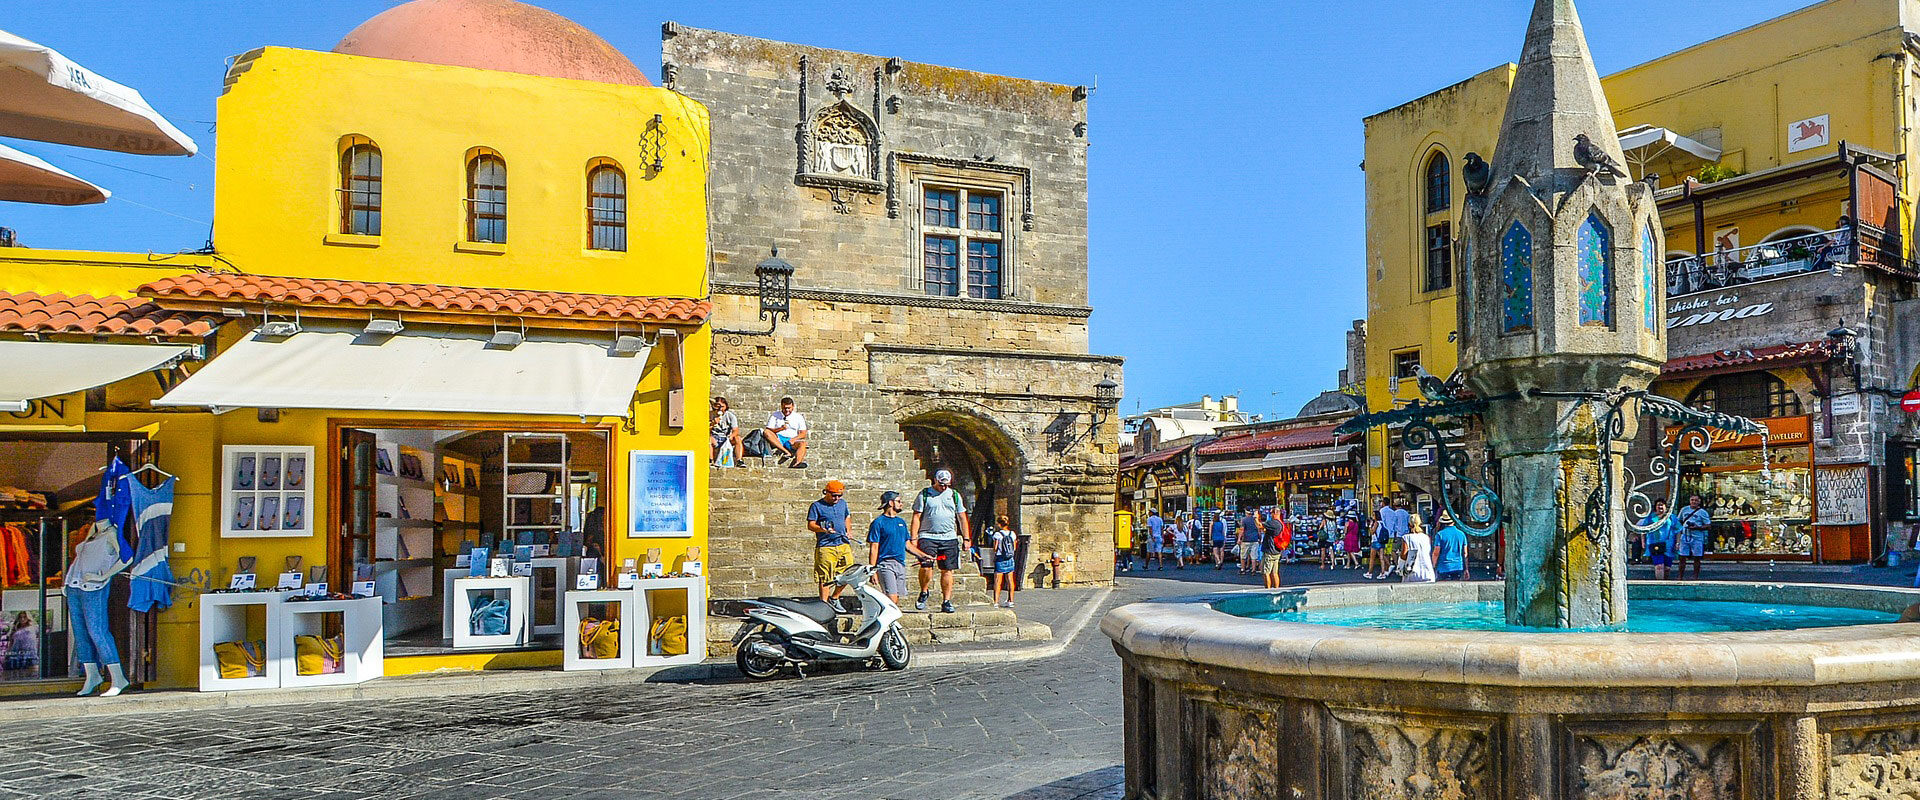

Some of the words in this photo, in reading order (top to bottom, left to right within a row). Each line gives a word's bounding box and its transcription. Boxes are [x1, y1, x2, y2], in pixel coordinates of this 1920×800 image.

[1668, 298, 1709, 313] shisha
[1287, 471, 1299, 481] LA
[1303, 466, 1350, 480] FONTANA
